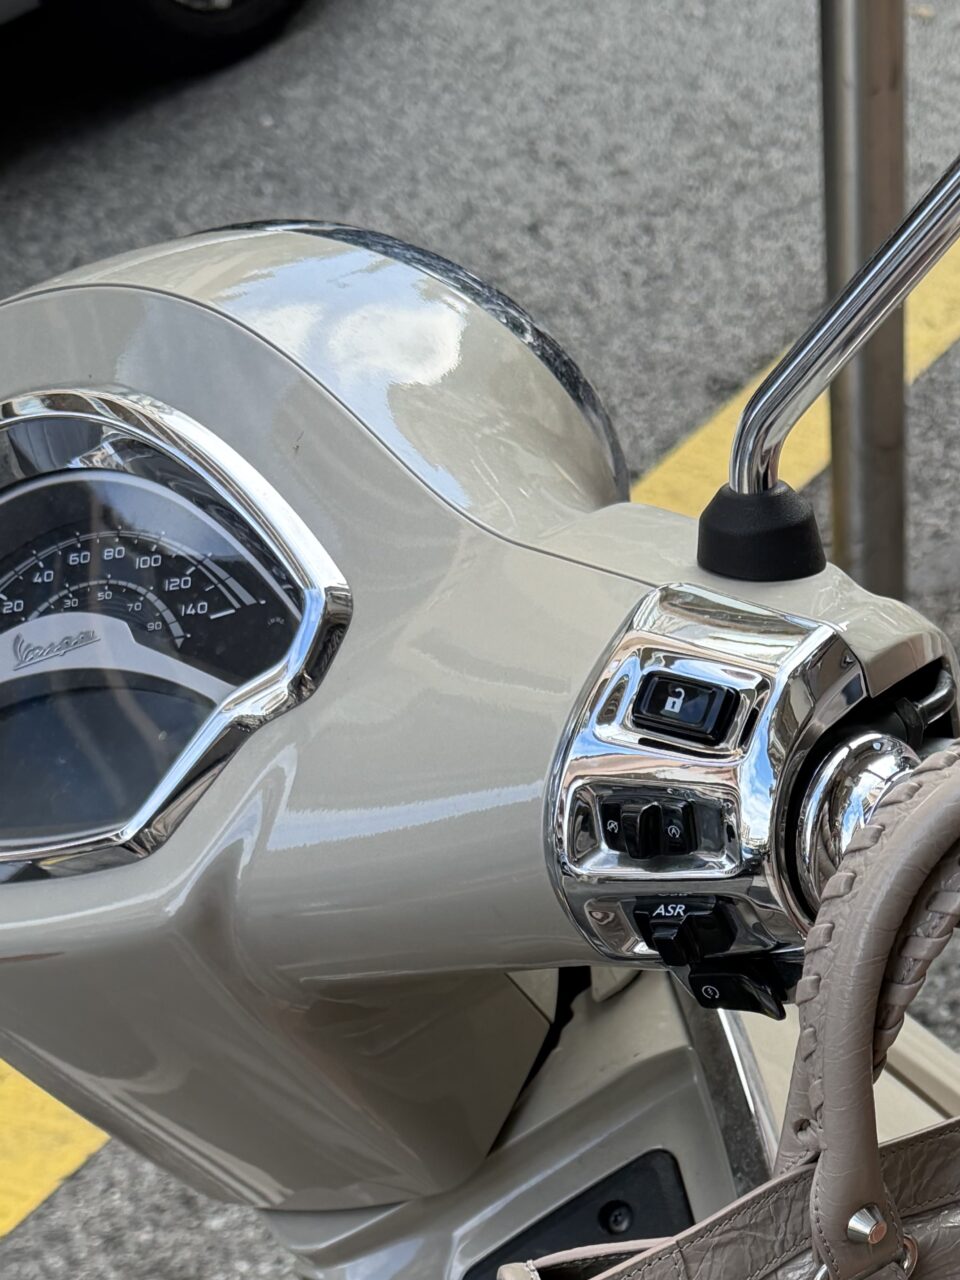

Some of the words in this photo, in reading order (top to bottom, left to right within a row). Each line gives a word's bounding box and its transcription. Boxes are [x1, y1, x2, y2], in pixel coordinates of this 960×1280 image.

[69, 552, 91, 565] 60
[104, 547, 125, 560] 80
[135, 555, 162, 569] 100
[33, 571, 54, 583] 40
[165, 577, 192, 591] 120
[97, 591, 113, 601] 50
[2, 600, 24, 614] 20
[64, 599, 79, 608] 30
[127, 603, 142, 612] 70
[181, 602, 208, 616] 140
[147, 622, 162, 631] 90
[652, 904, 686, 917] ASR
